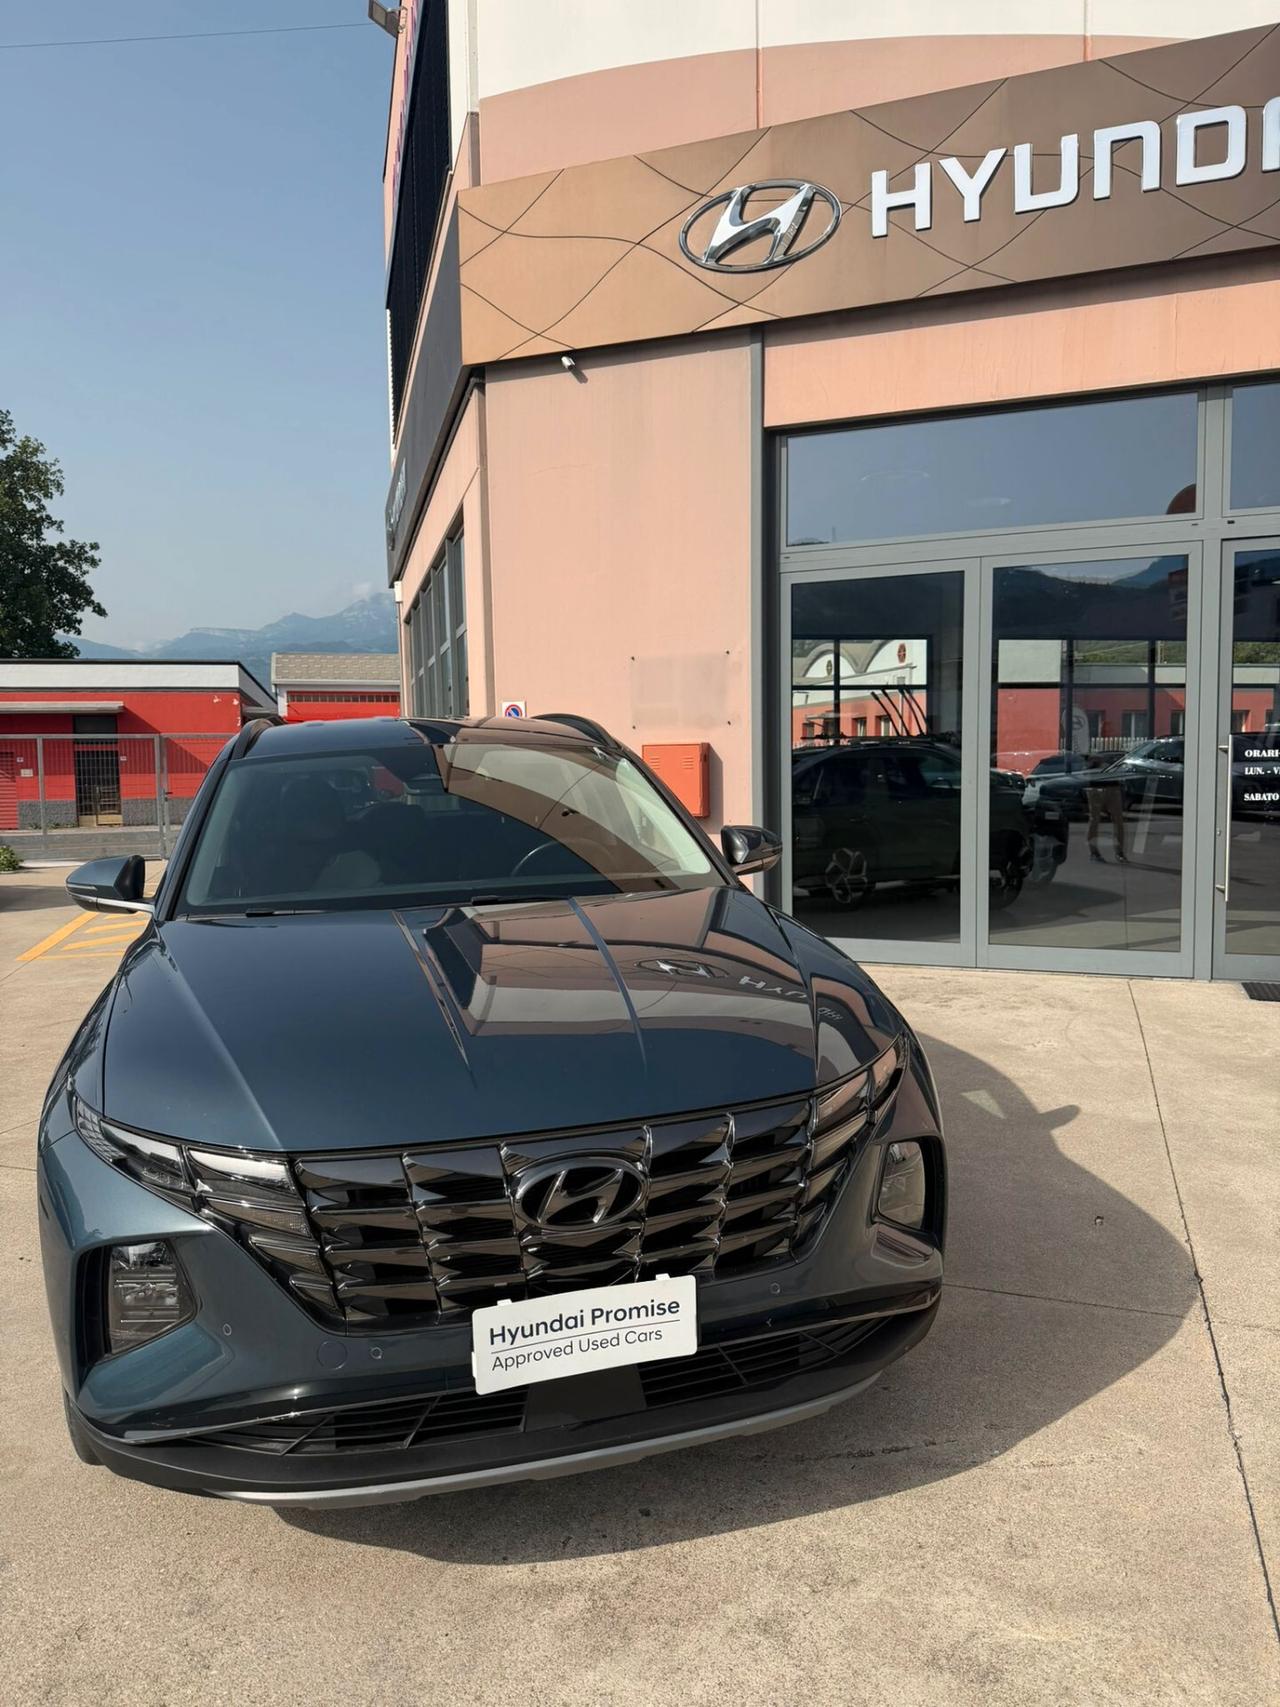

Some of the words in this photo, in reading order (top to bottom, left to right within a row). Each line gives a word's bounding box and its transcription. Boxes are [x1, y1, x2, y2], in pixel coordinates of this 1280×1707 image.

[872, 96, 1280, 238] HYUND
[1244, 749, 1280, 758] ORARI
[1244, 766, 1265, 775] LUN.
[1273, 766, 1280, 775] V
[1243, 792, 1280, 801] SABATO
[489, 1309, 585, 1346] Hyundai
[591, 1299, 681, 1326] Promise
[491, 1341, 574, 1372] Approved
[578, 1332, 620, 1353] Used
[624, 1329, 663, 1345] Cars
